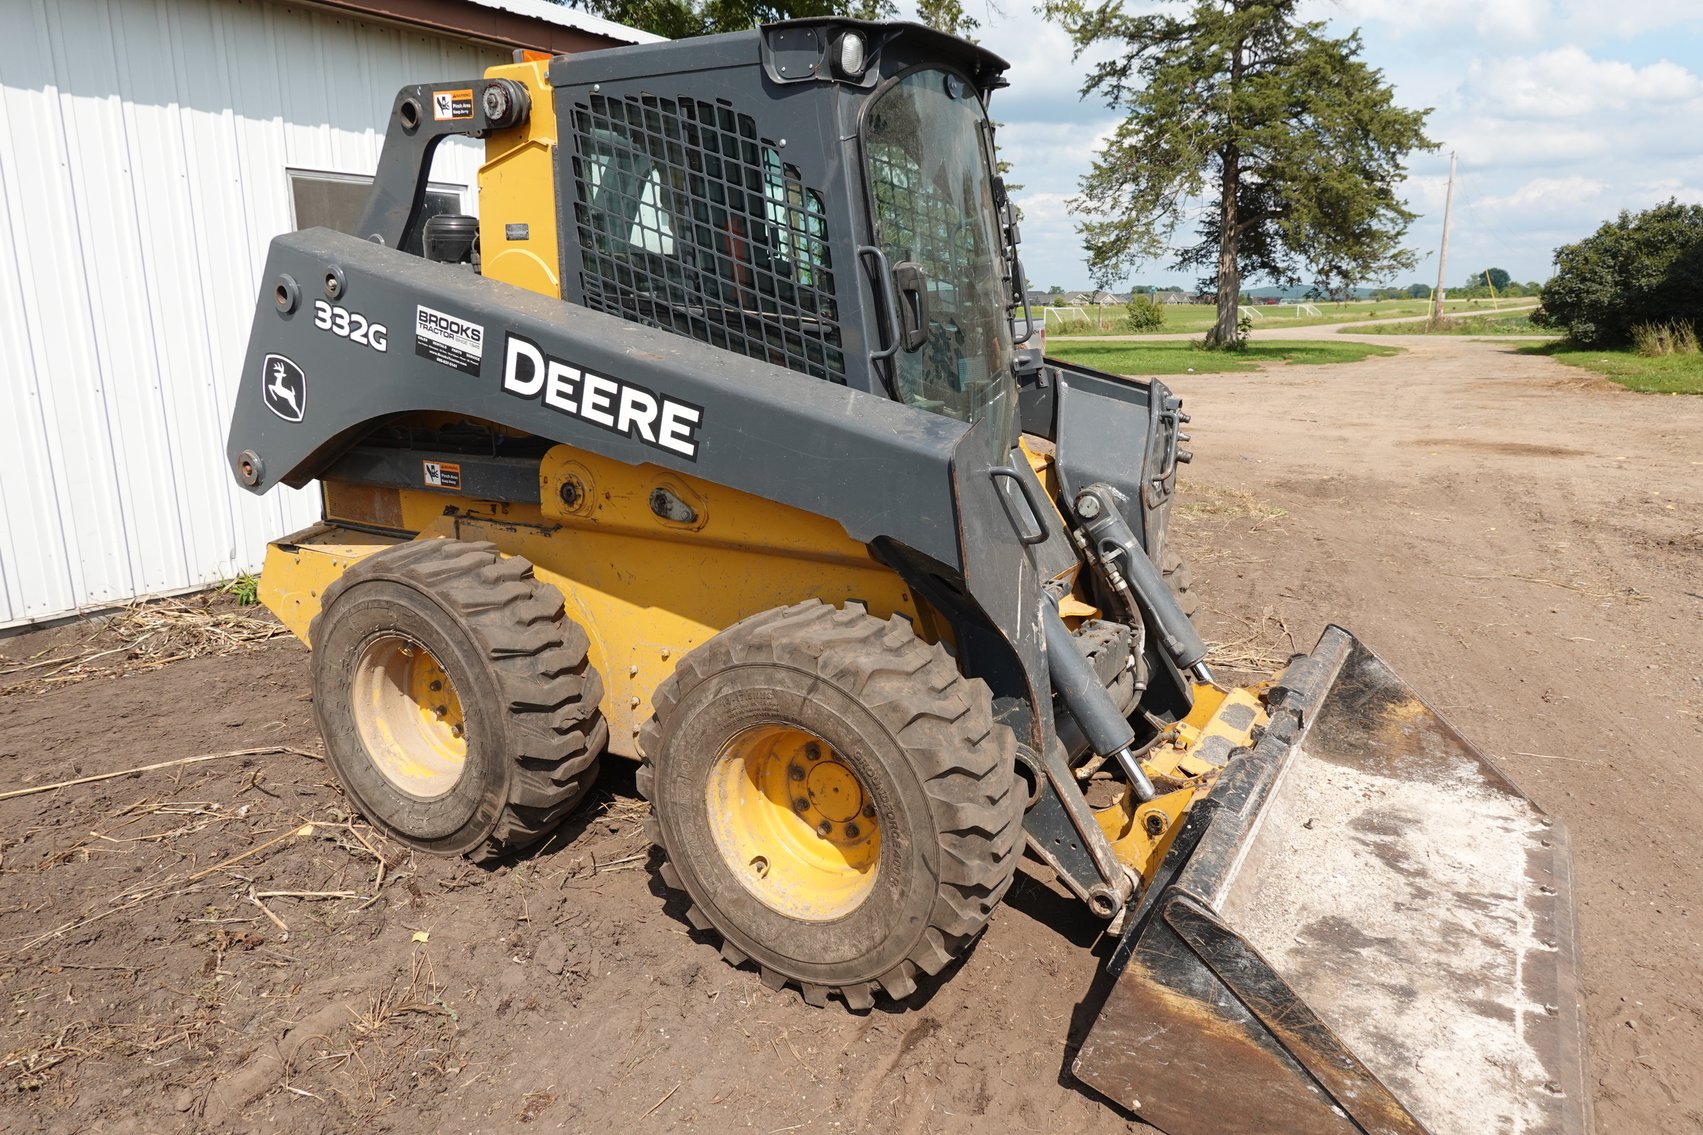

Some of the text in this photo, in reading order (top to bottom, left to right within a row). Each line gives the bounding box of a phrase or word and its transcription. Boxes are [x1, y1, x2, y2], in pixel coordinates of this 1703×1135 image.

[314, 300, 387, 352] 332G
[419, 310, 481, 342] BROOKS
[419, 322, 454, 340] TRACTOR
[504, 337, 700, 456] DEERE
